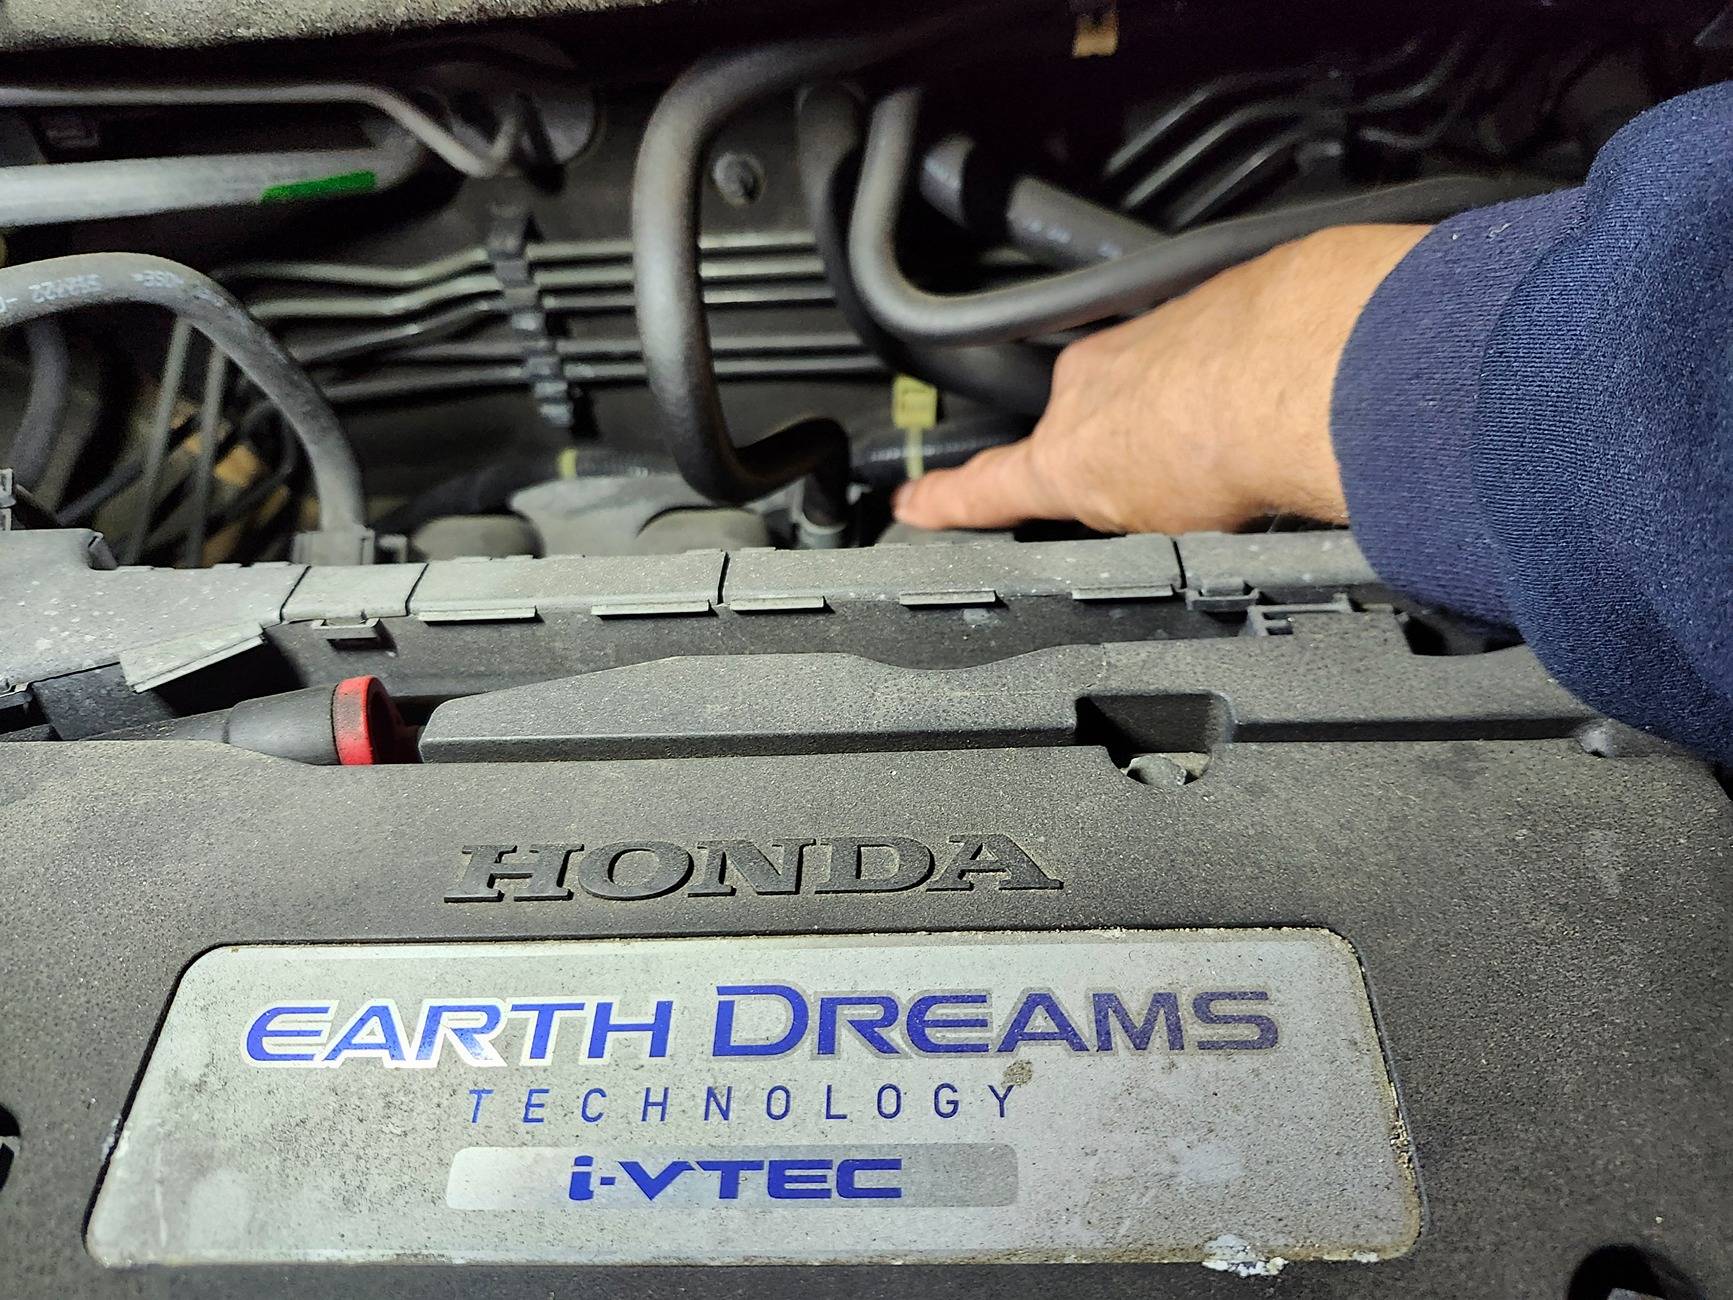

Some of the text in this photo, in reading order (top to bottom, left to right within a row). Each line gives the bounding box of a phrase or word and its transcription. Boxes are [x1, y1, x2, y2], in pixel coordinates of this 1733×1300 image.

[443, 835, 1065, 903] HONDA
[242, 983, 1279, 1067] EARTH DREAMS
[470, 1083, 1017, 1124] TECHNOLOGY
[568, 1155, 904, 1202] i-VTEC
